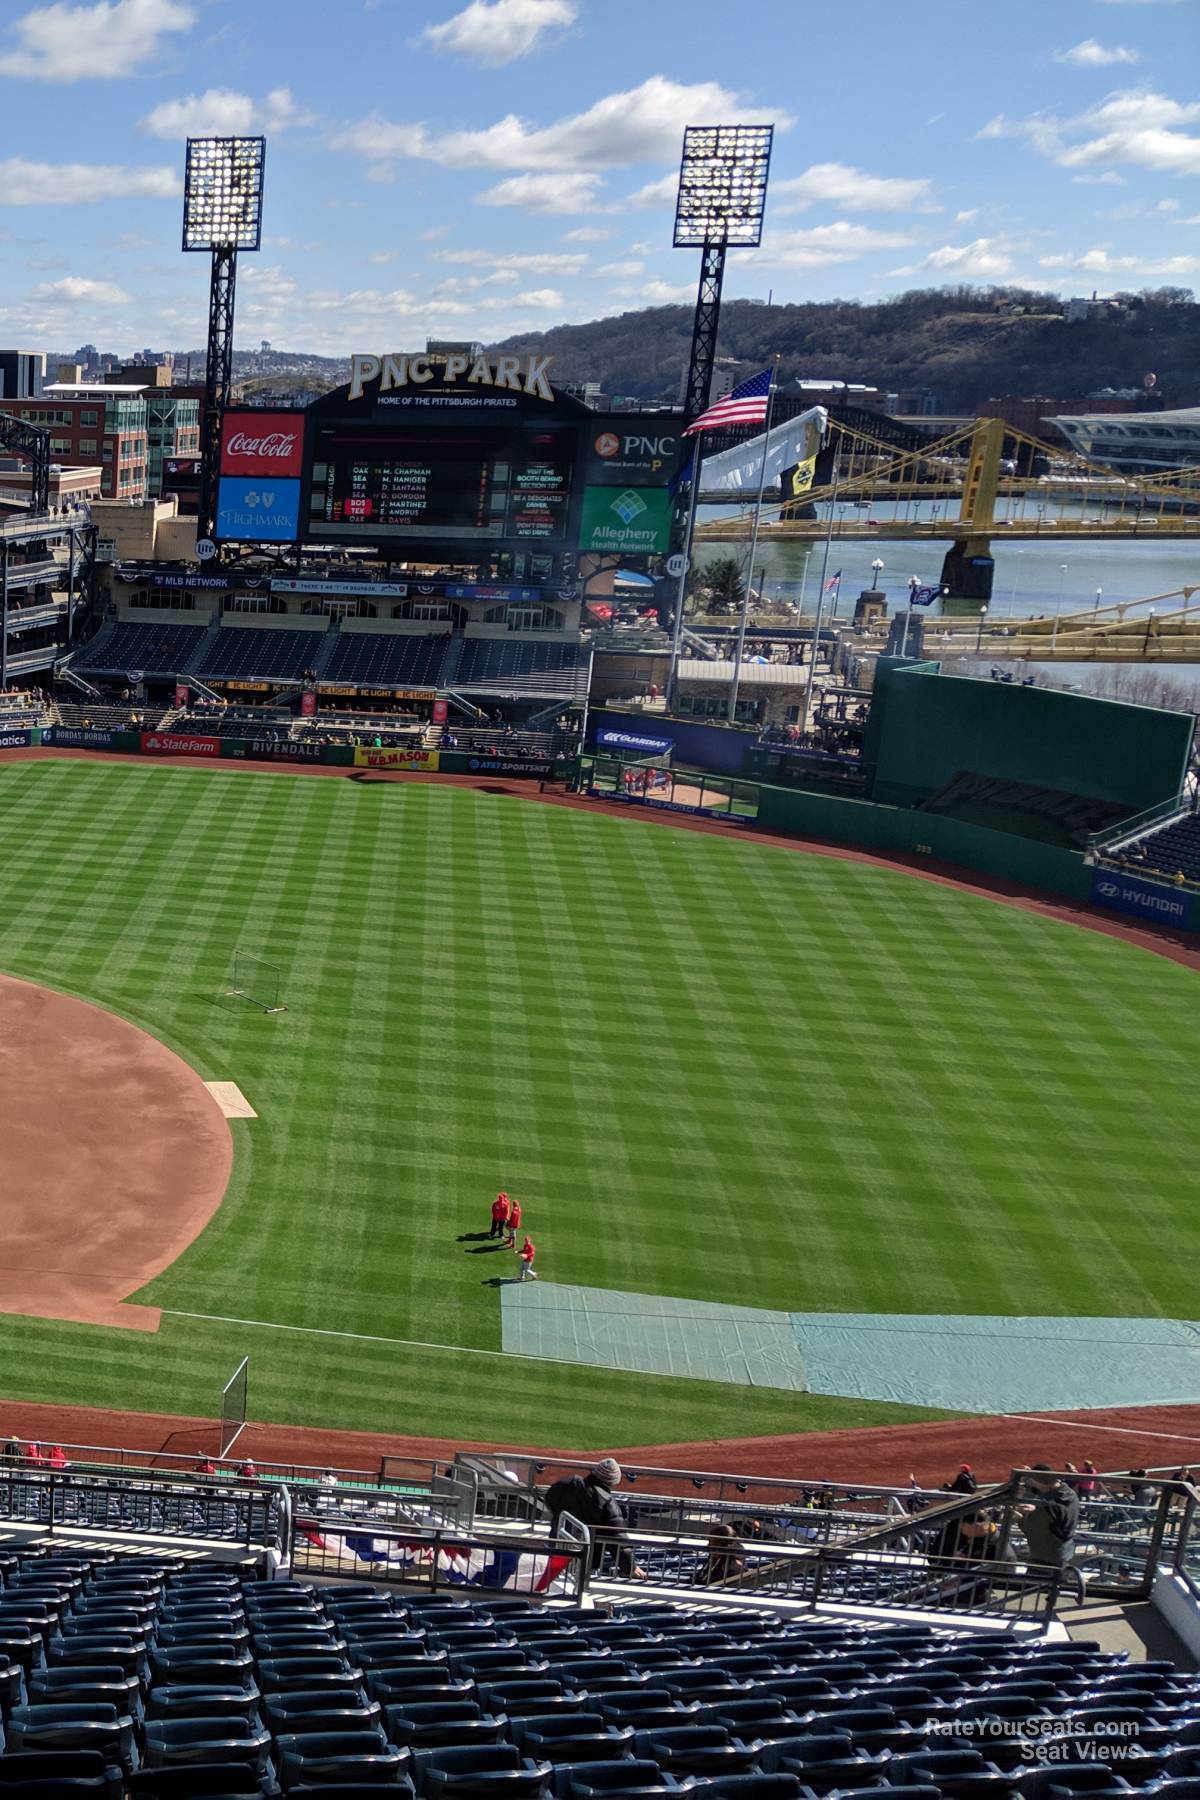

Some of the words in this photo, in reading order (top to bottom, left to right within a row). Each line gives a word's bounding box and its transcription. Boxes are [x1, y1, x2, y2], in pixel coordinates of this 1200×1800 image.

[348, 353, 435, 401] PNC
[443, 353, 555, 402] PARK
[377, 397, 401, 405] HOME
[401, 397, 413, 405] OF
[415, 397, 431, 406] THE
[431, 397, 482, 406] PITTSBURGH
[483, 398, 517, 407] PIRATES
[623, 436, 676, 455] PNC
[224, 512, 292, 527] HIGHMARK
[592, 527, 658, 541] Allegheny
[197, 544, 214, 555] Lite
[591, 541, 619, 550] Health
[619, 542, 656, 551] Network
[165, 576, 183, 585] MLB
[185, 577, 228, 587] NETWORK
[245, 682, 264, 691] LIGHT
[331, 687, 352, 695] LIGHT
[370, 689, 392, 698] LIGHT
[412, 691, 434, 700] LIGHT
[56, 731, 82, 740] BORDAS
[84, 732, 111, 742] BORDAS
[618, 734, 669, 748] GUARDIAN
[252, 742, 320, 756] RIVENDALE
[480, 761, 501, 769] AT&T
[501, 762, 551, 773] SPORTSNET
[1122, 888, 1184, 916] HYUNDAI
